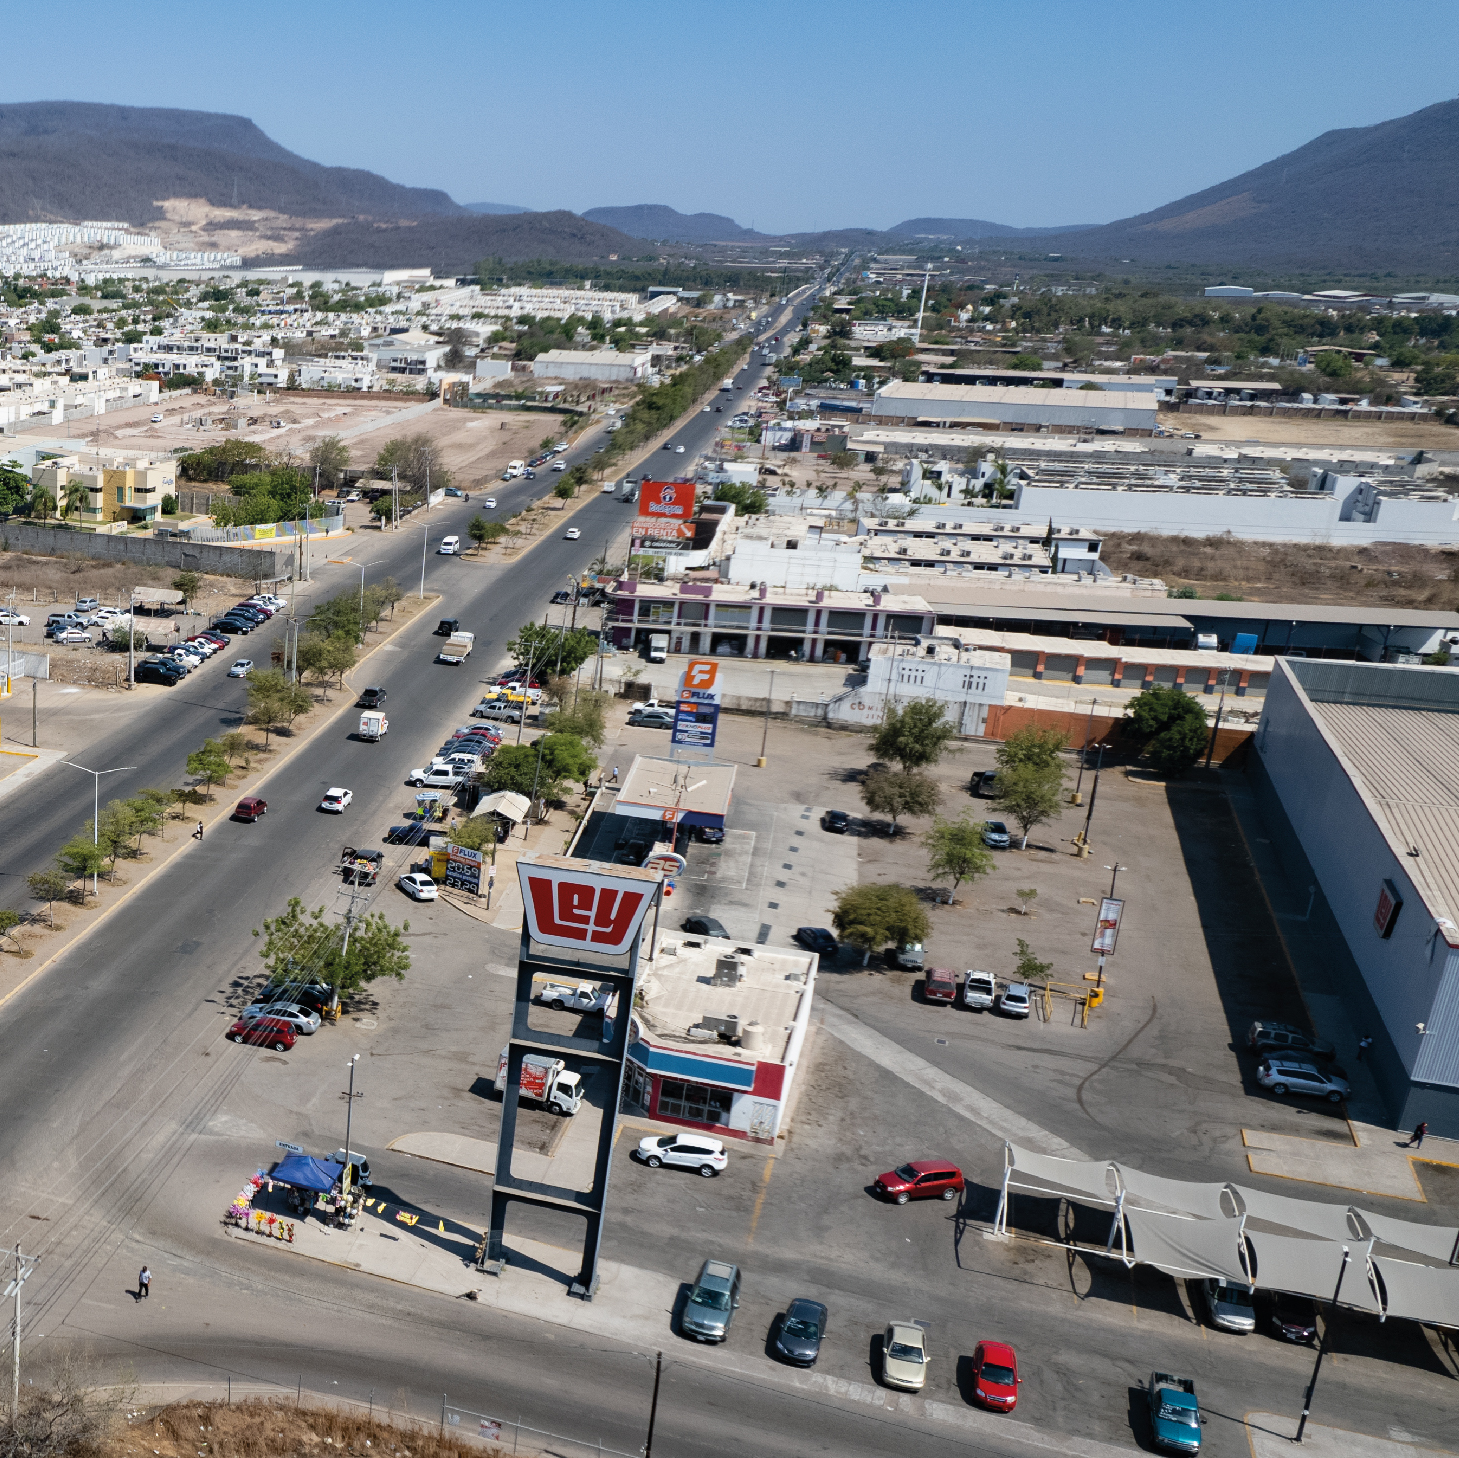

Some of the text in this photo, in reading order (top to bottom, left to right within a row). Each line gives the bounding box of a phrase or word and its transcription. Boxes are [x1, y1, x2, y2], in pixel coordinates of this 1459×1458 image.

[632, 528, 678, 537] EN RENTA
[691, 691, 717, 700] FLUX
[459, 848, 478, 859] FLUX
[528, 876, 644, 946] Ley
